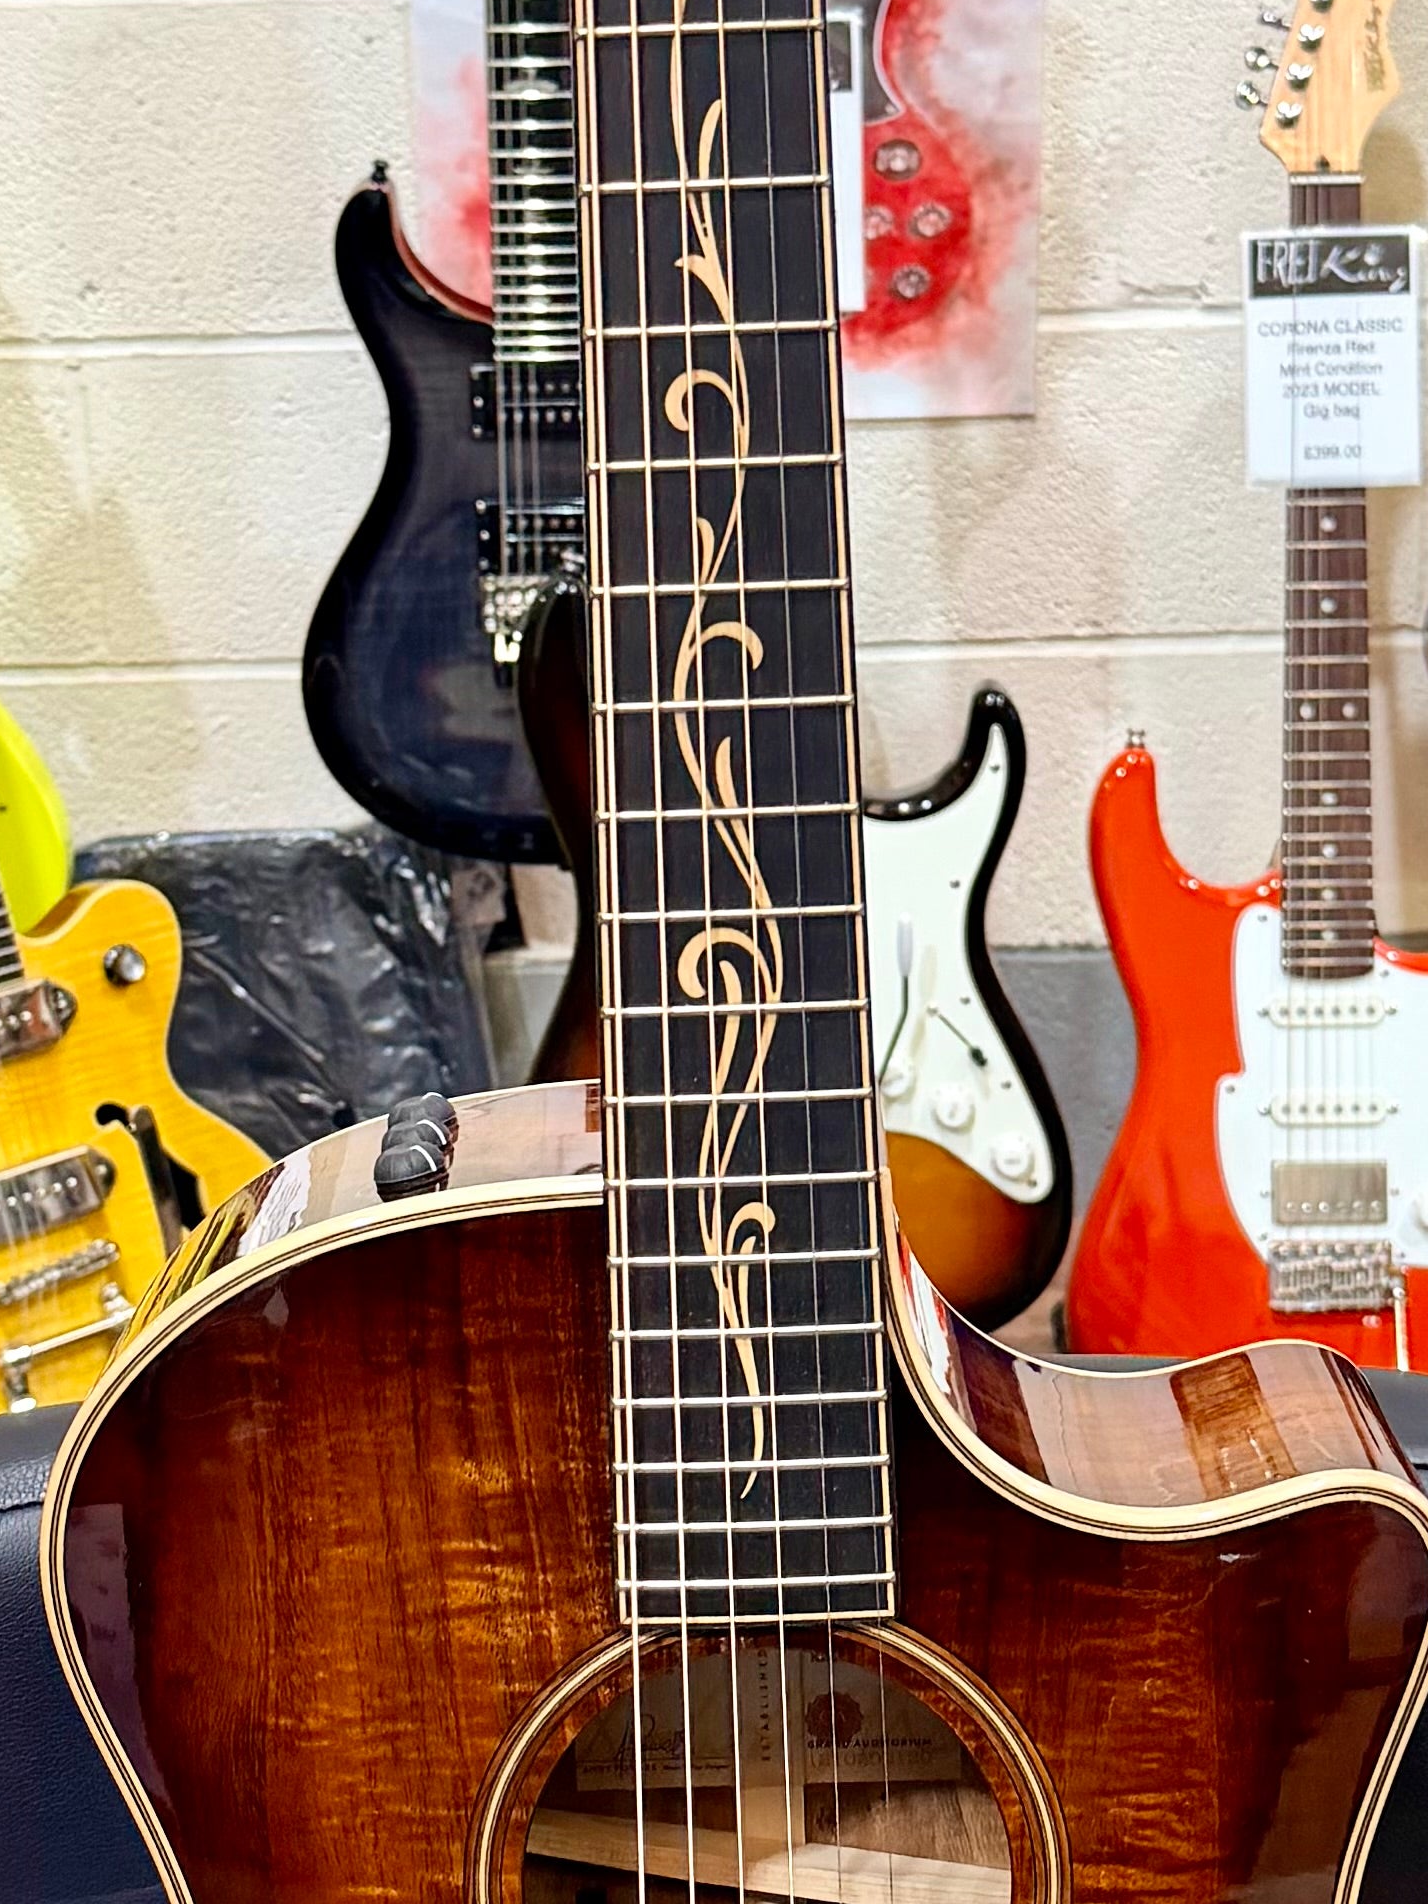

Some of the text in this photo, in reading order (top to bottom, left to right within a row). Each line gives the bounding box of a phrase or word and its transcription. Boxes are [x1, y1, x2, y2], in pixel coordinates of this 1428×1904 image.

[1257, 318, 1404, 337] CORONA CLASSIC
[1345, 340, 1376, 355] Red
[1279, 360, 1383, 379] Mint Condition
[1323, 383, 1381, 398] MODEL
[1333, 403, 1361, 421] bag
